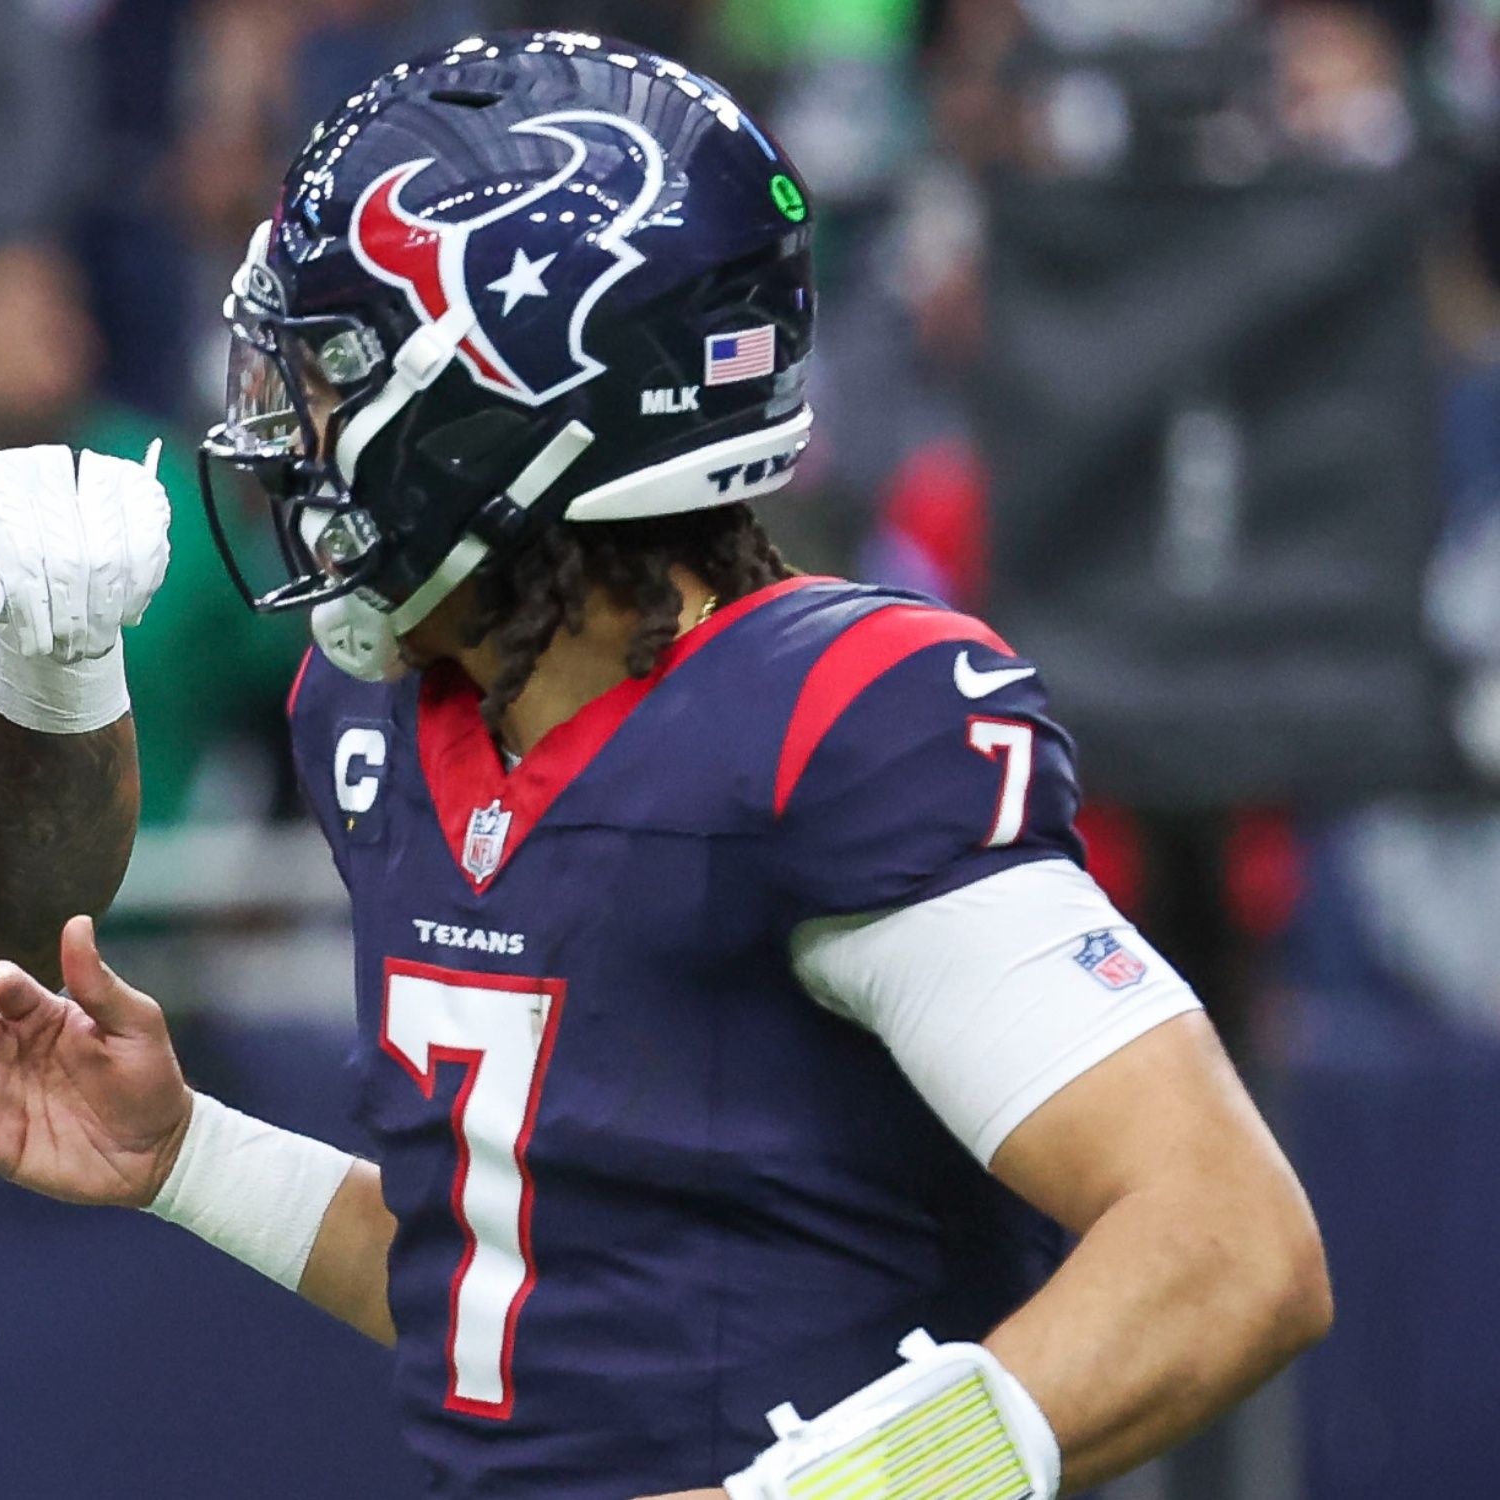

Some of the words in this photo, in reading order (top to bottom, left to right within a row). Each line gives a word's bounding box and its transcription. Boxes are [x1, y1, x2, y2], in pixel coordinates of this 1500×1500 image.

[639, 385, 700, 415] MLK
[334, 727, 387, 813] C
[965, 713, 1036, 848] 7
[412, 918, 526, 955] TEXANS
[379, 956, 569, 1421] 7
